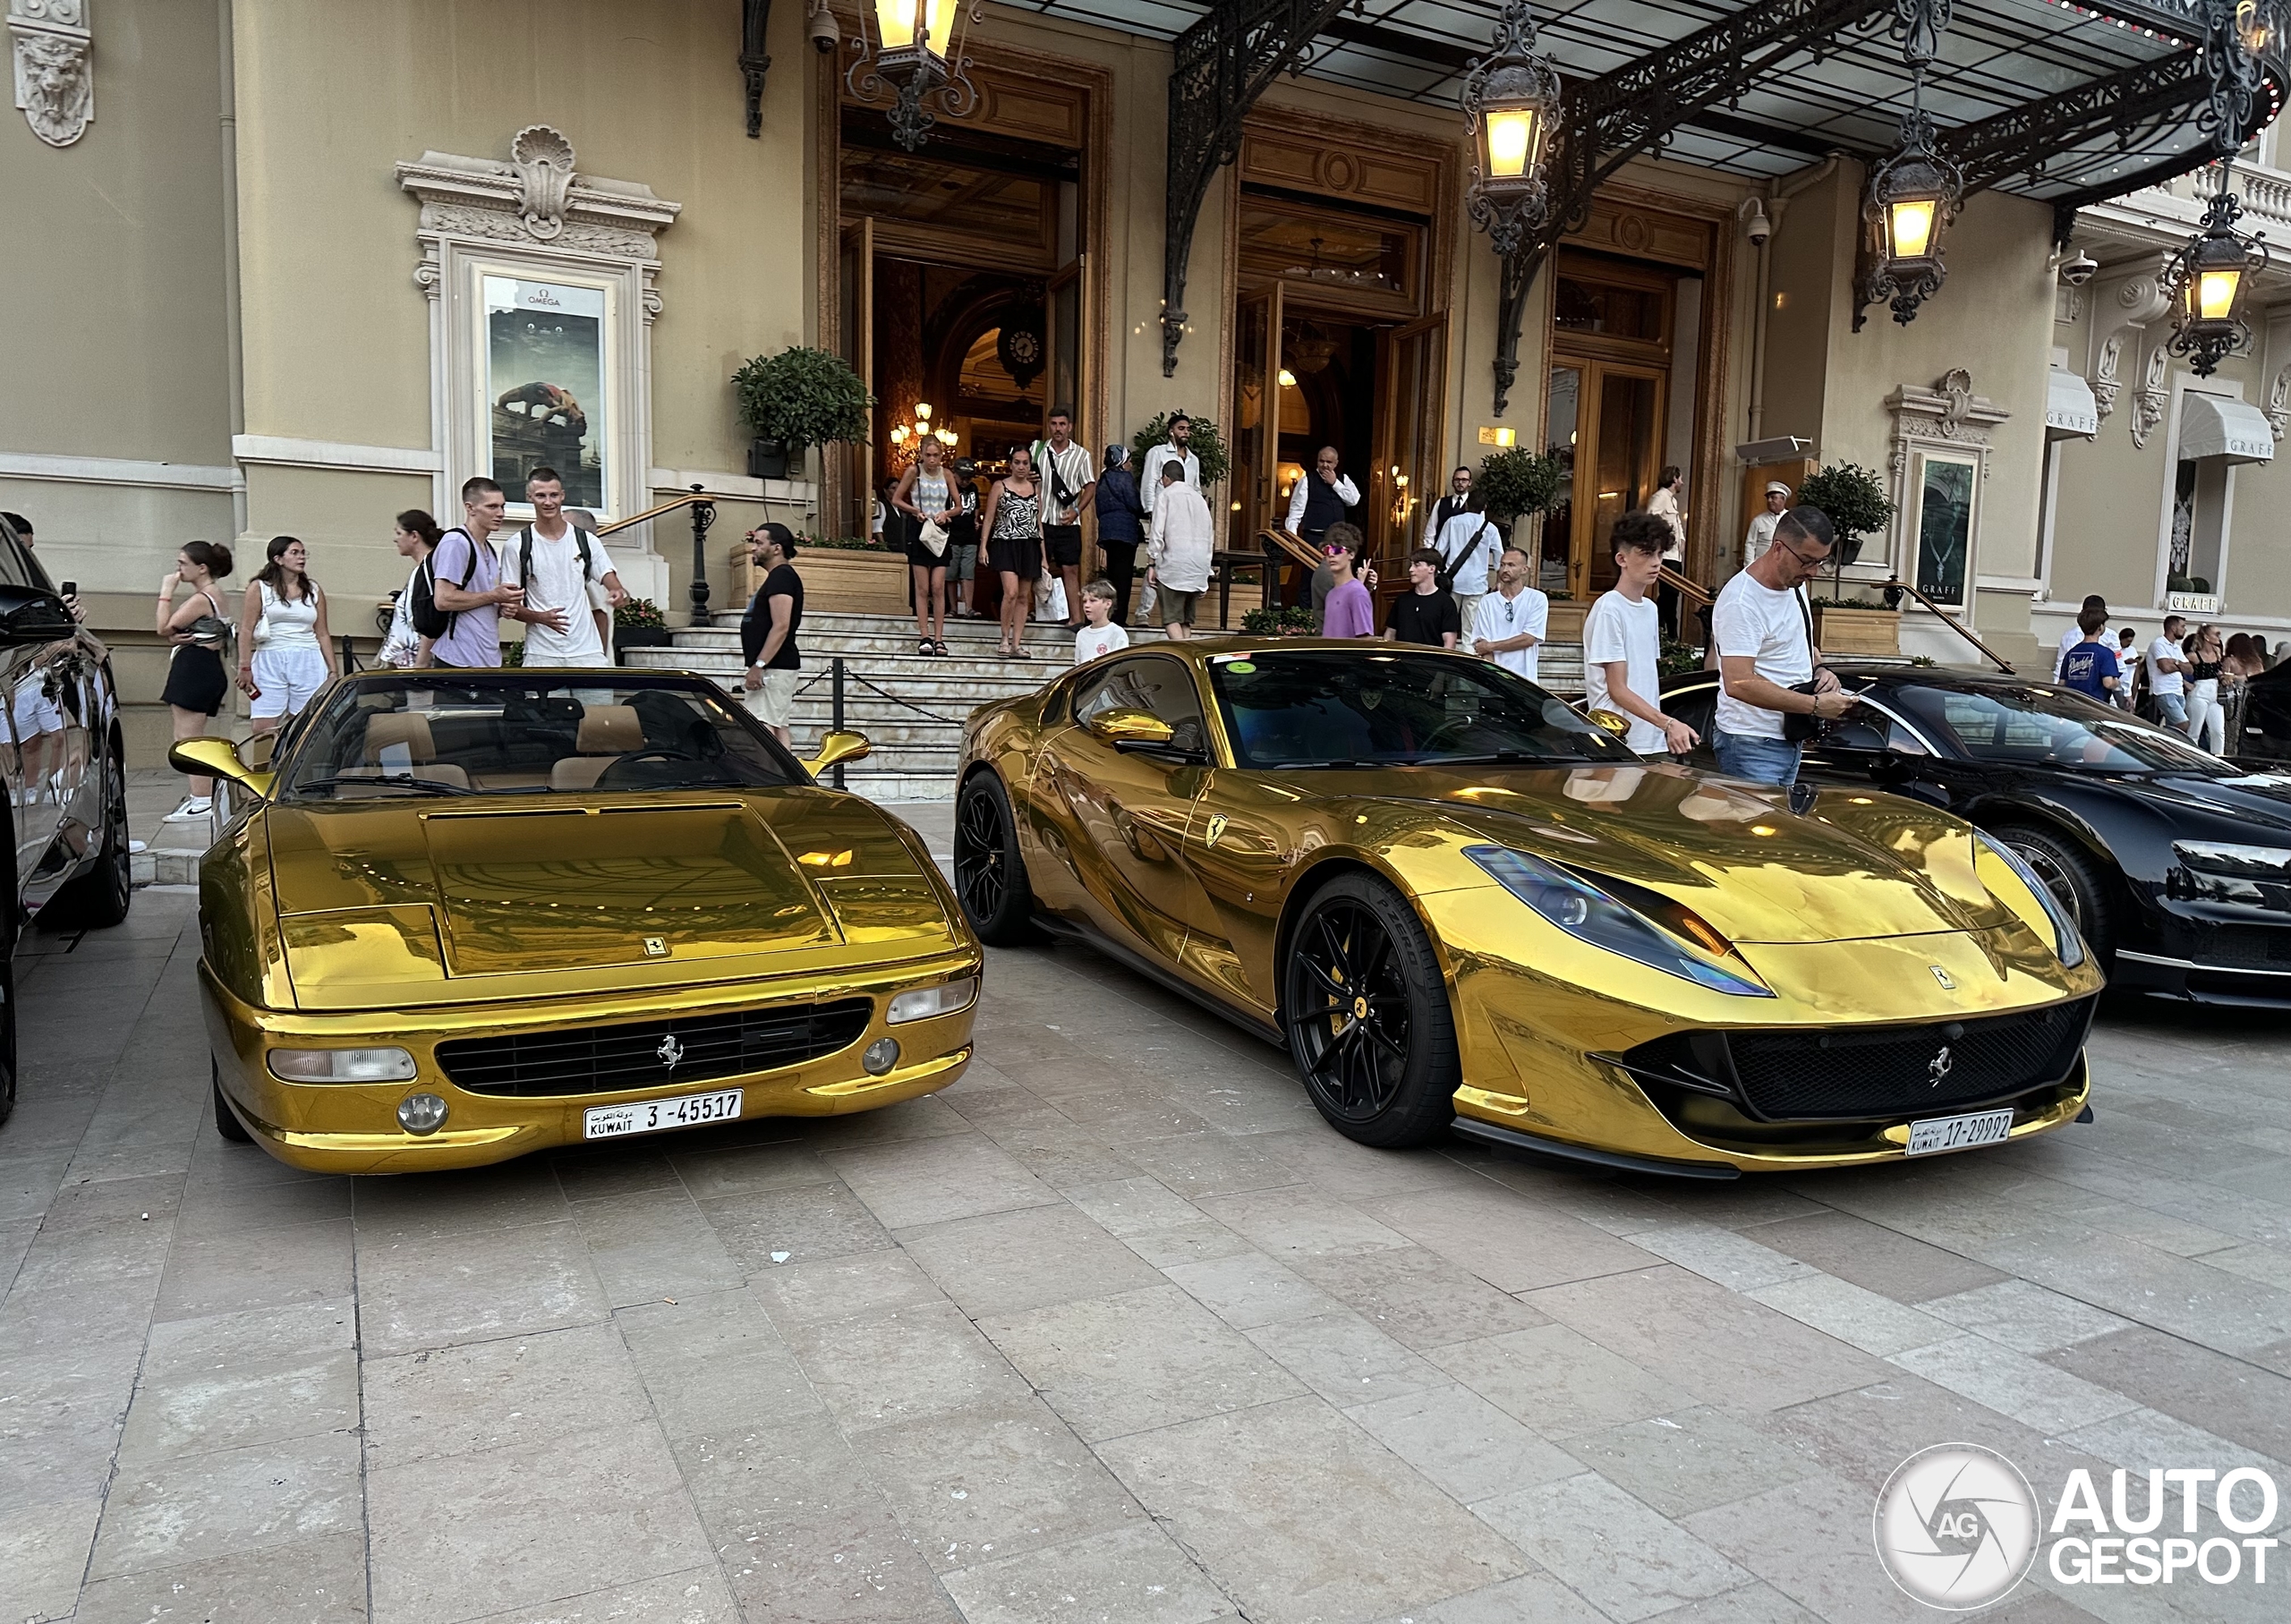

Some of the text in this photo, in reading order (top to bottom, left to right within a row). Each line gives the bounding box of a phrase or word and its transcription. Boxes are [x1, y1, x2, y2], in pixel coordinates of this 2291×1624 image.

[528, 296, 561, 306] OMEGA
[2047, 411, 2095, 430] GRAFF
[2230, 439, 2273, 455] GRAFF
[1922, 584, 1956, 595] GRAFF
[2173, 596, 2217, 610] GRAFF
[1376, 898, 1418, 965] P ZERO
[591, 1119, 633, 1135] KUWAIT
[1944, 1115, 2009, 1146] 17-29992
[1911, 1137, 1940, 1152] KUWAIT
